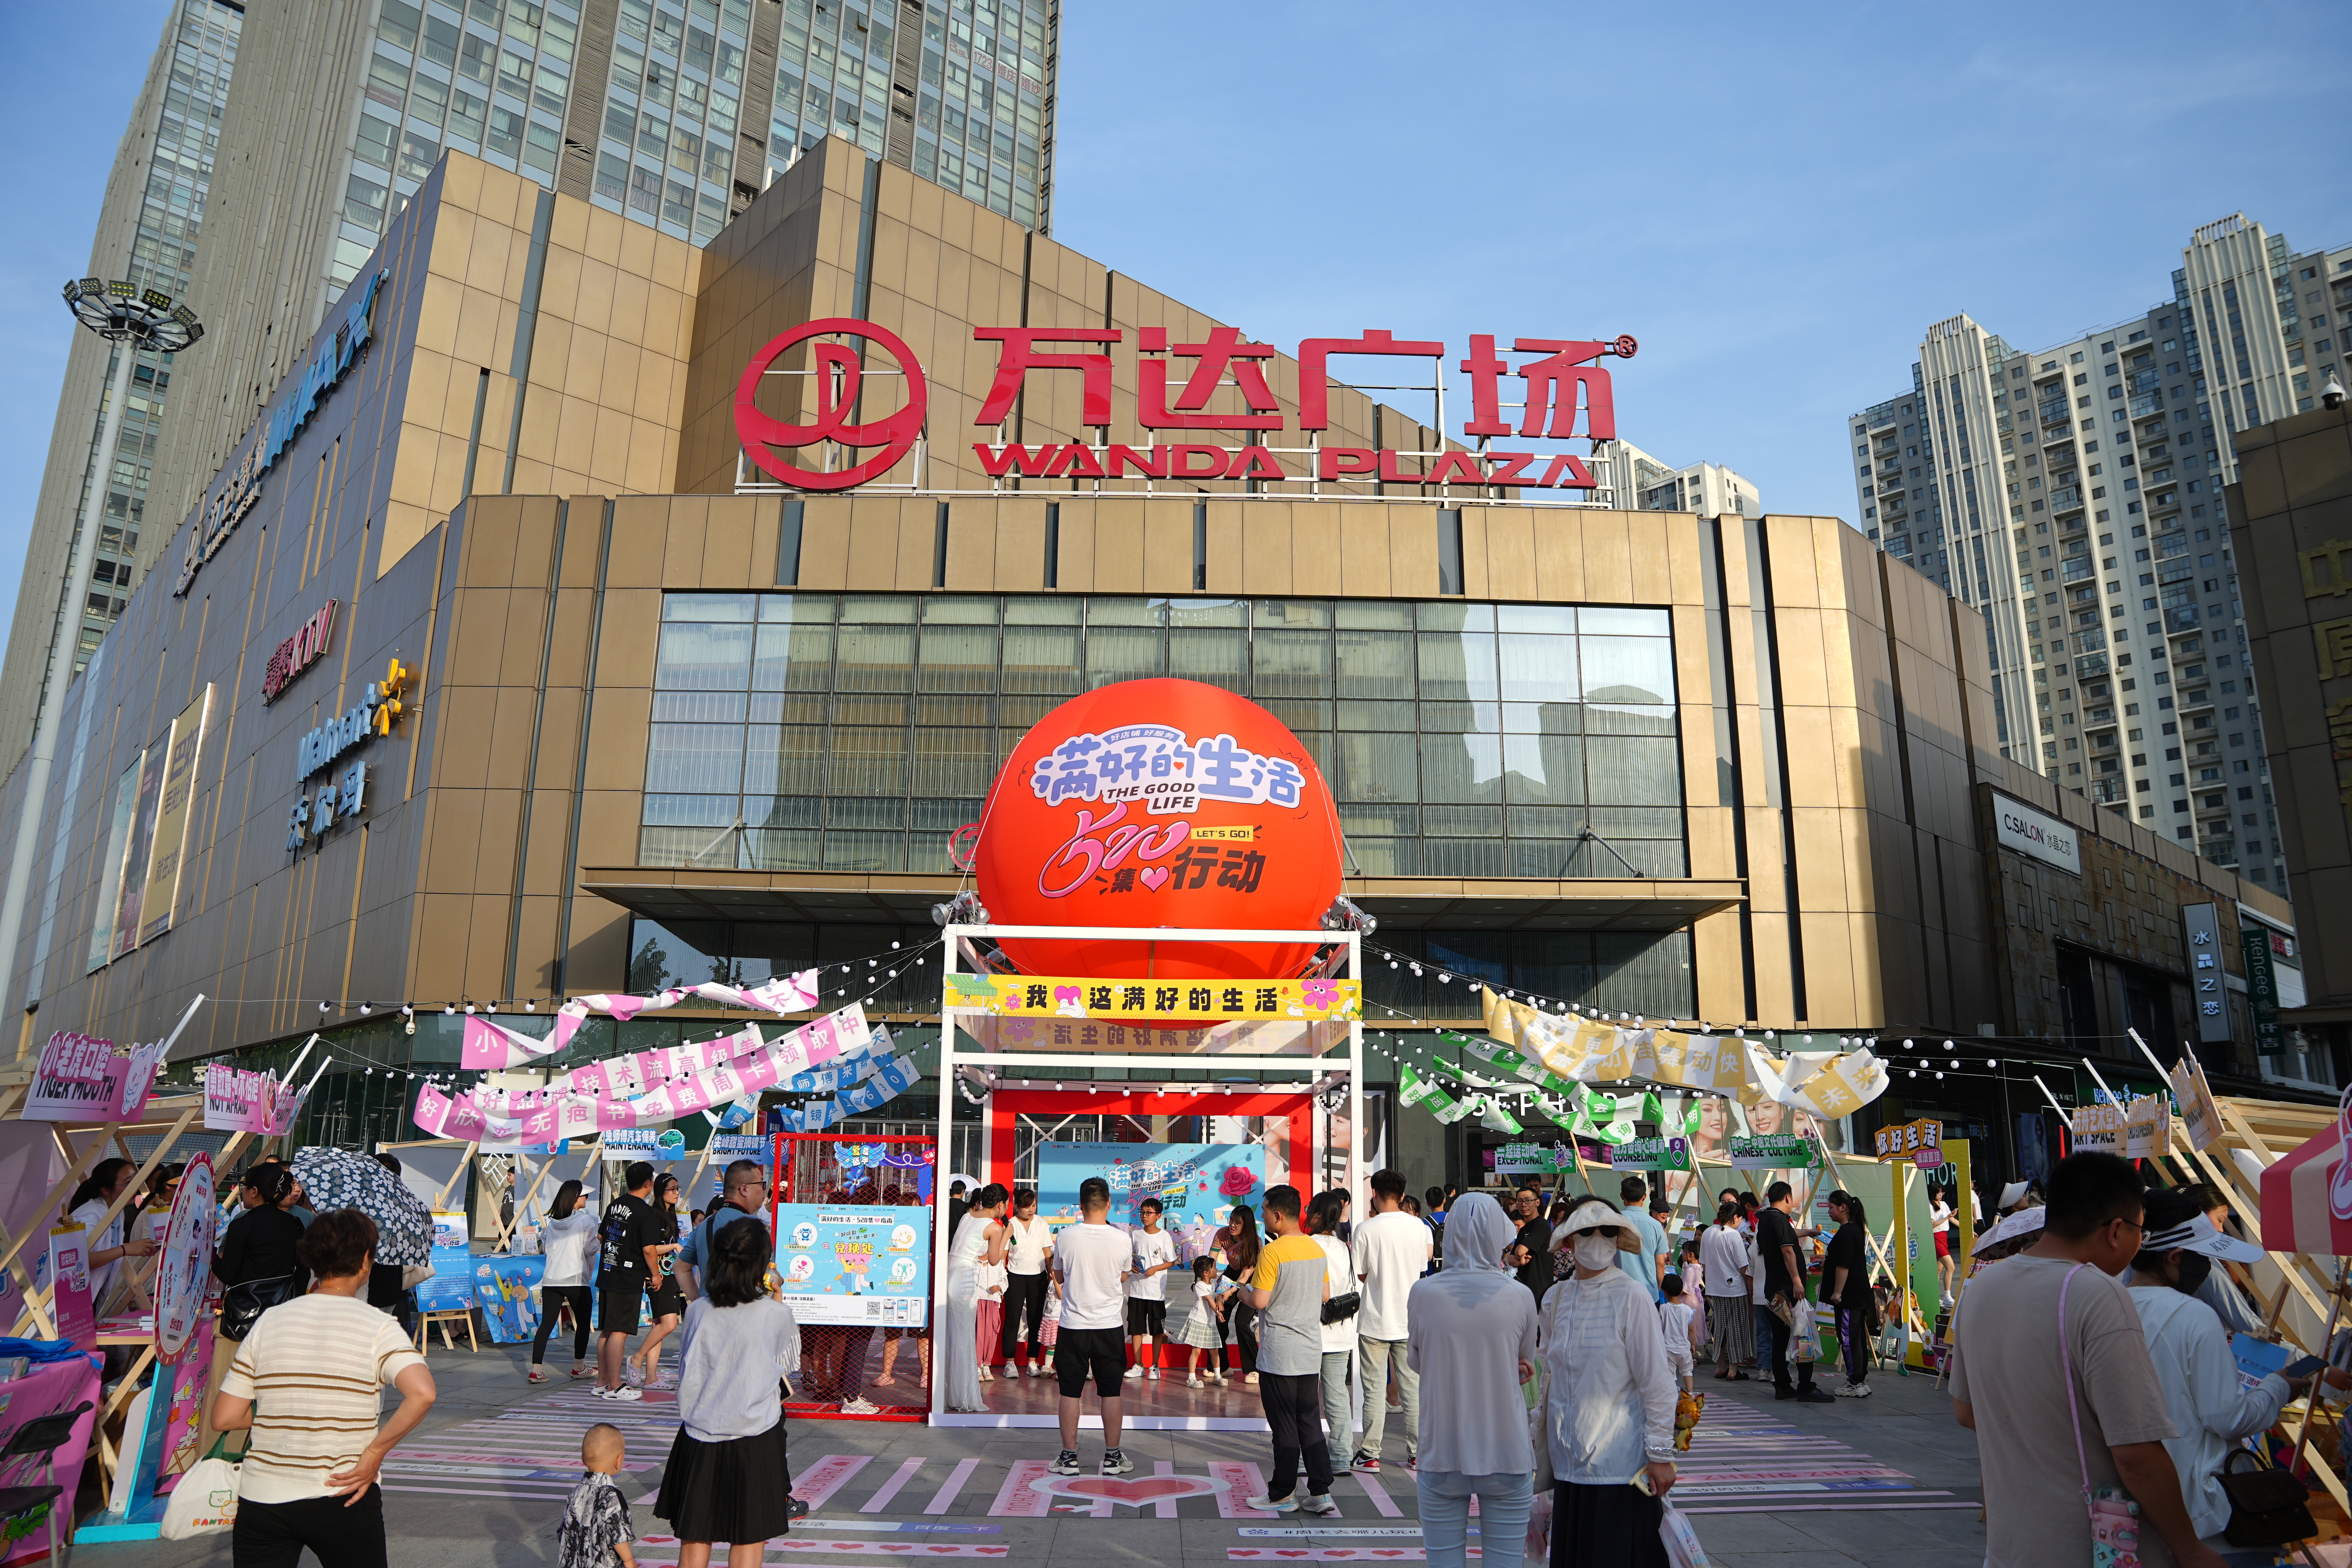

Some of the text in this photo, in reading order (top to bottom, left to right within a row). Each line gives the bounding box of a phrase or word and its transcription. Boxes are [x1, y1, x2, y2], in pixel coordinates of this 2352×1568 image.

[261, 273, 371, 473] IMAX
[974, 327, 1614, 440] 万达广场
[974, 443, 1597, 488] WANDA PLAZA
[289, 599, 337, 677] KTV
[298, 683, 375, 782] Walmart
[1110, 728, 1176, 742] 好店铺 好服务
[1035, 738, 1300, 804] 满好的生活
[1108, 782, 1195, 799] THE GOOD
[285, 761, 365, 852] 沃尔玛
[1152, 797, 1195, 810] LIFE
[1197, 828, 1251, 839] LET'S GO!
[2047, 831, 2071, 856] 水晶之恋
[1114, 846, 1266, 893] 集 行动
[2193, 929, 2220, 1016] 水晶之恋
[1026, 985, 1278, 1012] 我 这满好的生活
[2259, 1023, 2278, 1048] 仟吉
[42, 1036, 112, 1081] 小老虎口腔
[71, 1076, 117, 1101] MOUTH
[605, 1130, 656, 1143] 兔师傅汽车保养
[605, 1143, 655, 1151] MAINTENANCE
[714, 1135, 766, 1148] 尖峰甜蜜摘镜节
[1877, 1123, 1937, 1156] 你好生活
[2074, 1132, 2115, 1145] ART SPACE
[1497, 1143, 1538, 1158] 一起运动吧
[1733, 1145, 1803, 1158] CHINESE CULTURE
[1917, 1152, 1940, 1164] 浪漫置顶
[1109, 1161, 1195, 1189] 满好的生活
[1159, 1195, 1187, 1210] 行动
[835, 1241, 874, 1256] 兑换处
[446, 1454, 542, 1465] ZHENG
[1699, 1468, 1887, 1481] ZHENG ZHOU
[1834, 1481, 1899, 1489] 百度一下
[19, 1509, 50, 1532] SUMMER
